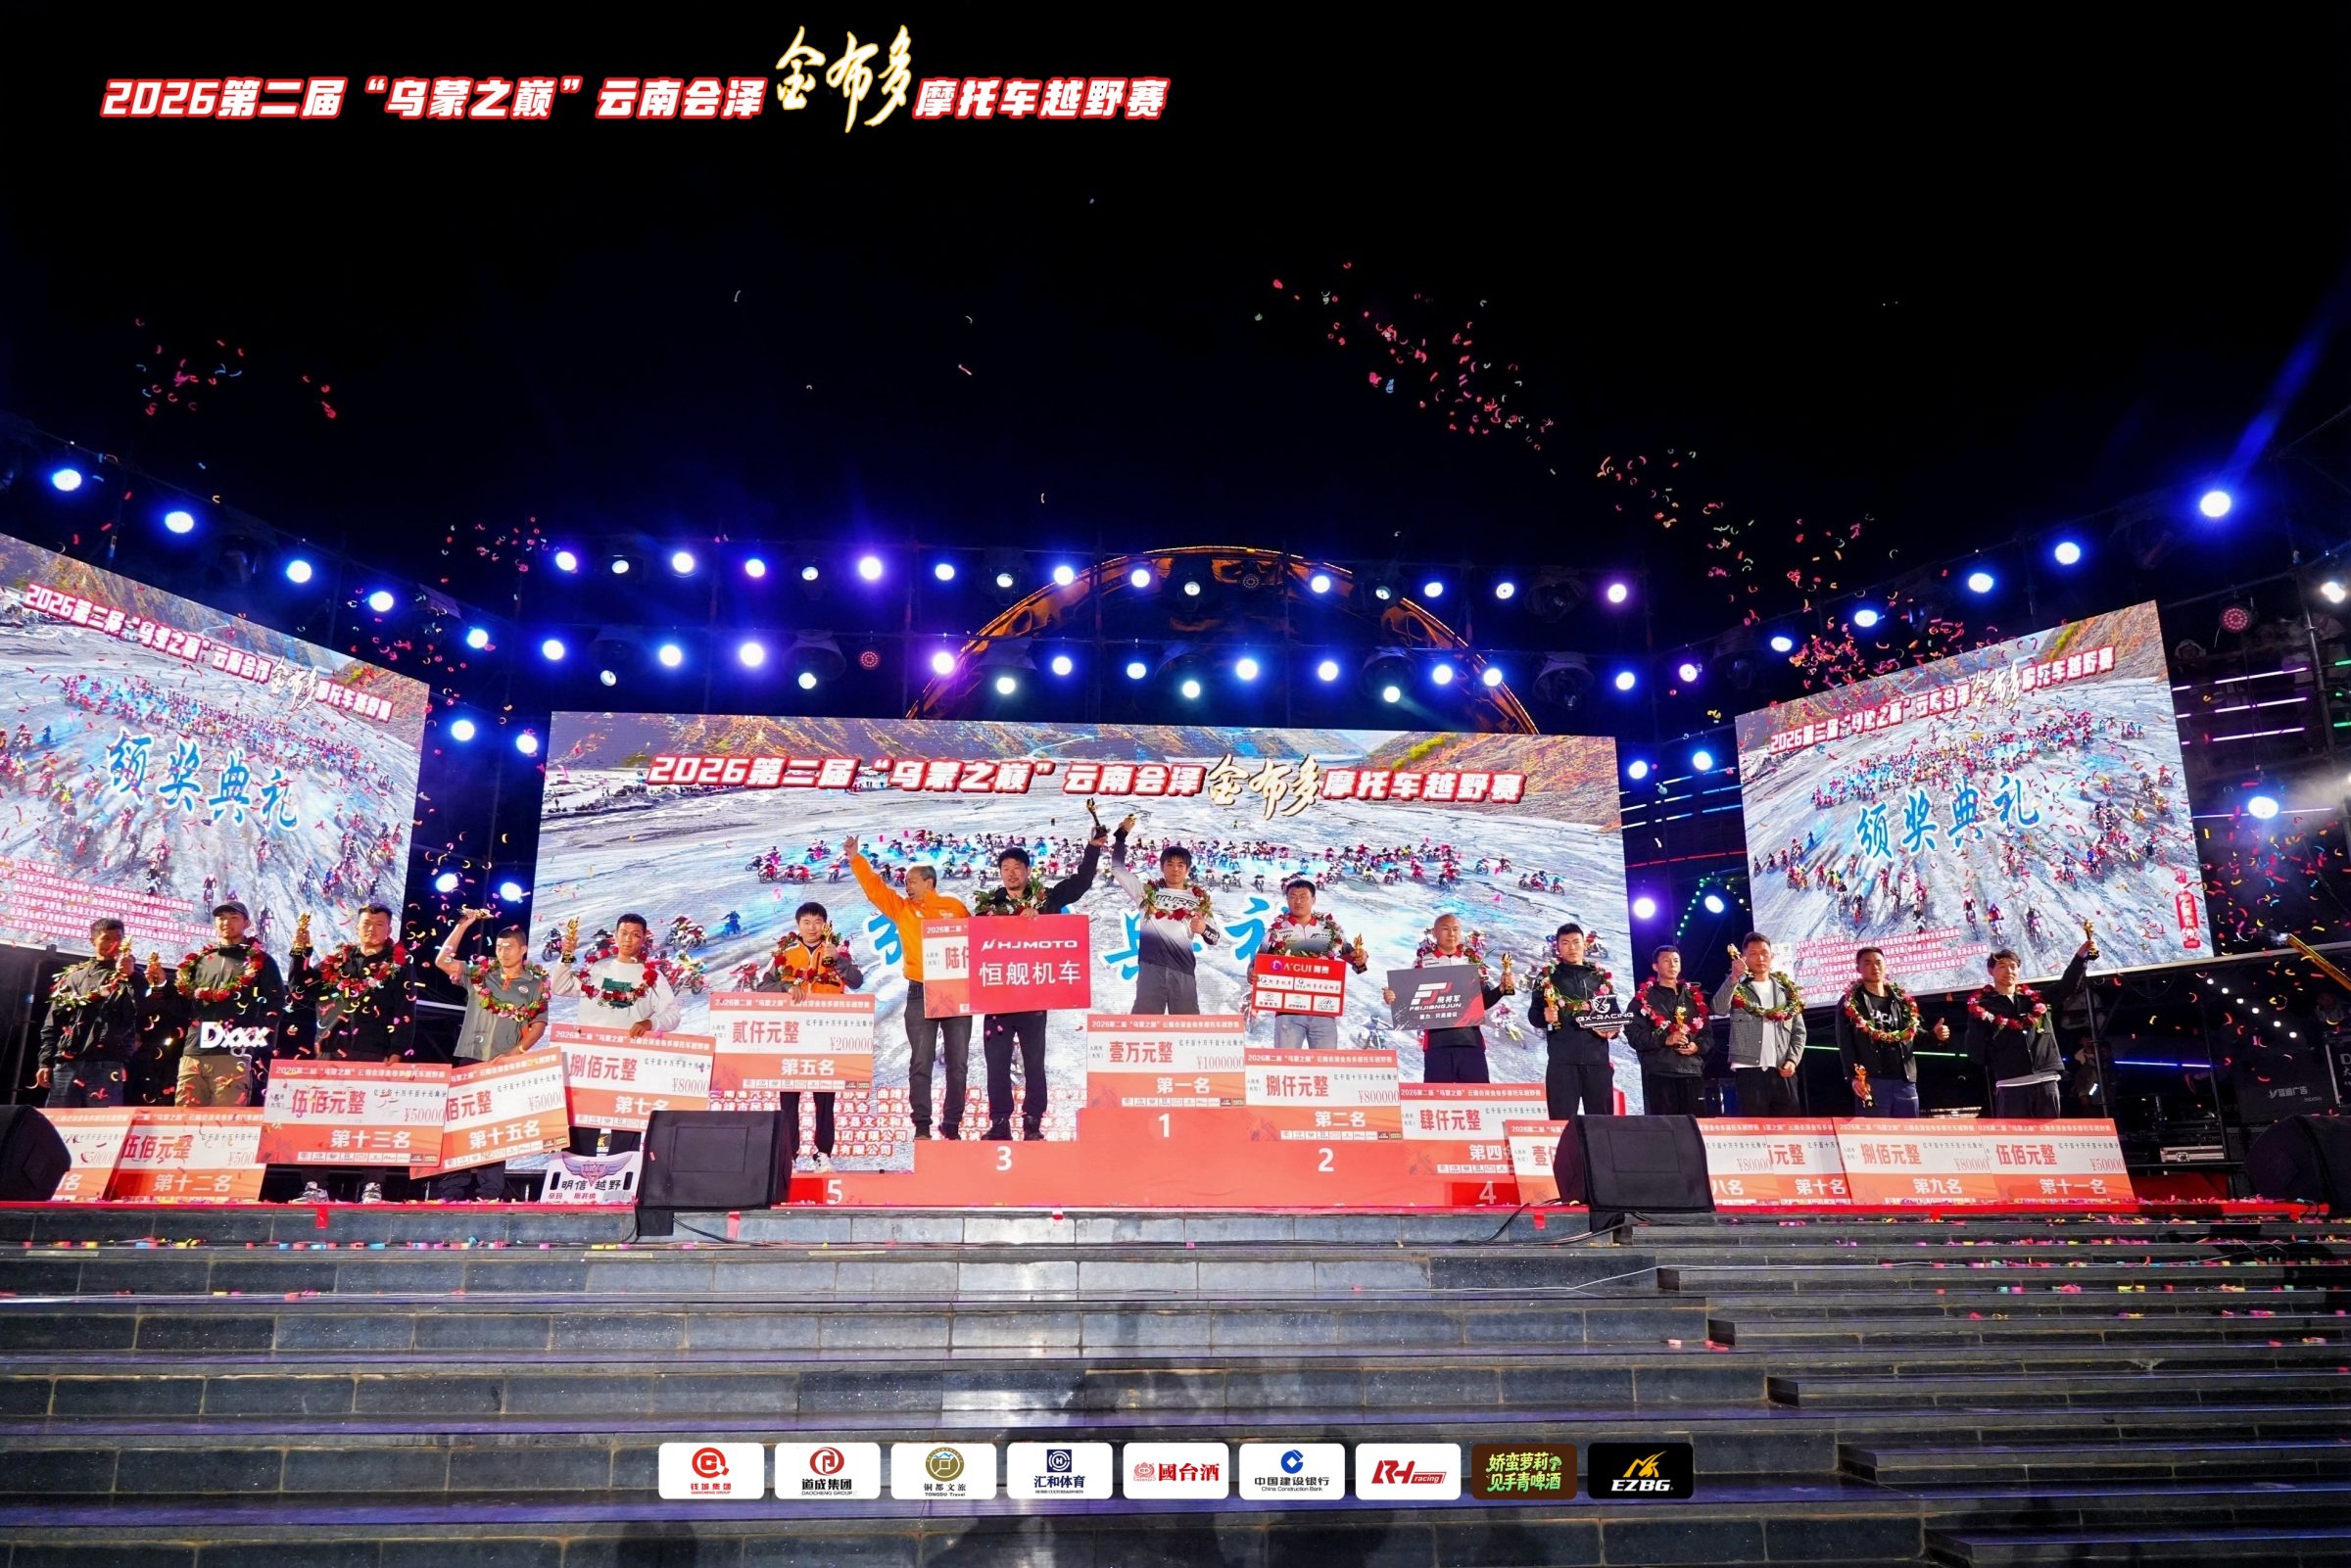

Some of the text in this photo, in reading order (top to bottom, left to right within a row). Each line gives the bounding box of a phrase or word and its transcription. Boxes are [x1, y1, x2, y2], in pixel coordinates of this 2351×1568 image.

[107, 726, 300, 832] 颁奖典礼
[1855, 773, 2042, 860] 颁奖典礼
[998, 940, 1078, 949] HJMOTO
[979, 960, 1081, 987] 恒舰机车
[1577, 1012, 1635, 1022] GX-RACING
[732, 1020, 800, 1044] 贰仟元整
[1109, 1041, 1174, 1064] 壹万元整
[568, 1053, 639, 1082] 捌佰元整
[781, 1058, 836, 1076] 第五名
[1156, 1076, 1211, 1094] 第一名
[1266, 1074, 1329, 1098] 捌仟元整
[291, 1088, 367, 1115] 伍佰元整
[1158, 1113, 1171, 1138] 1
[1315, 1111, 1366, 1128] 第二名
[1419, 1109, 1482, 1131] 肆仟元整
[330, 1129, 412, 1149] 第十三名
[468, 1119, 541, 1150] 第十五名
[120, 1133, 194, 1161] 伍佰元整
[995, 1145, 1013, 1171] 3
[1860, 1143, 1922, 1165] 捌佰元整
[1995, 1143, 2057, 1165] 伍佰元整
[1318, 1147, 1334, 1172] 2
[61, 1172, 82, 1191] 名
[152, 1173, 233, 1193] 第十二名
[561, 1179, 621, 1191] 明信 越野
[826, 1178, 843, 1205] 5
[1478, 1180, 1497, 1205] 4
[1795, 1178, 1847, 1196] 第十名
[1913, 1177, 1963, 1195] 第九名
[2039, 1177, 2107, 1195] 第十一名
